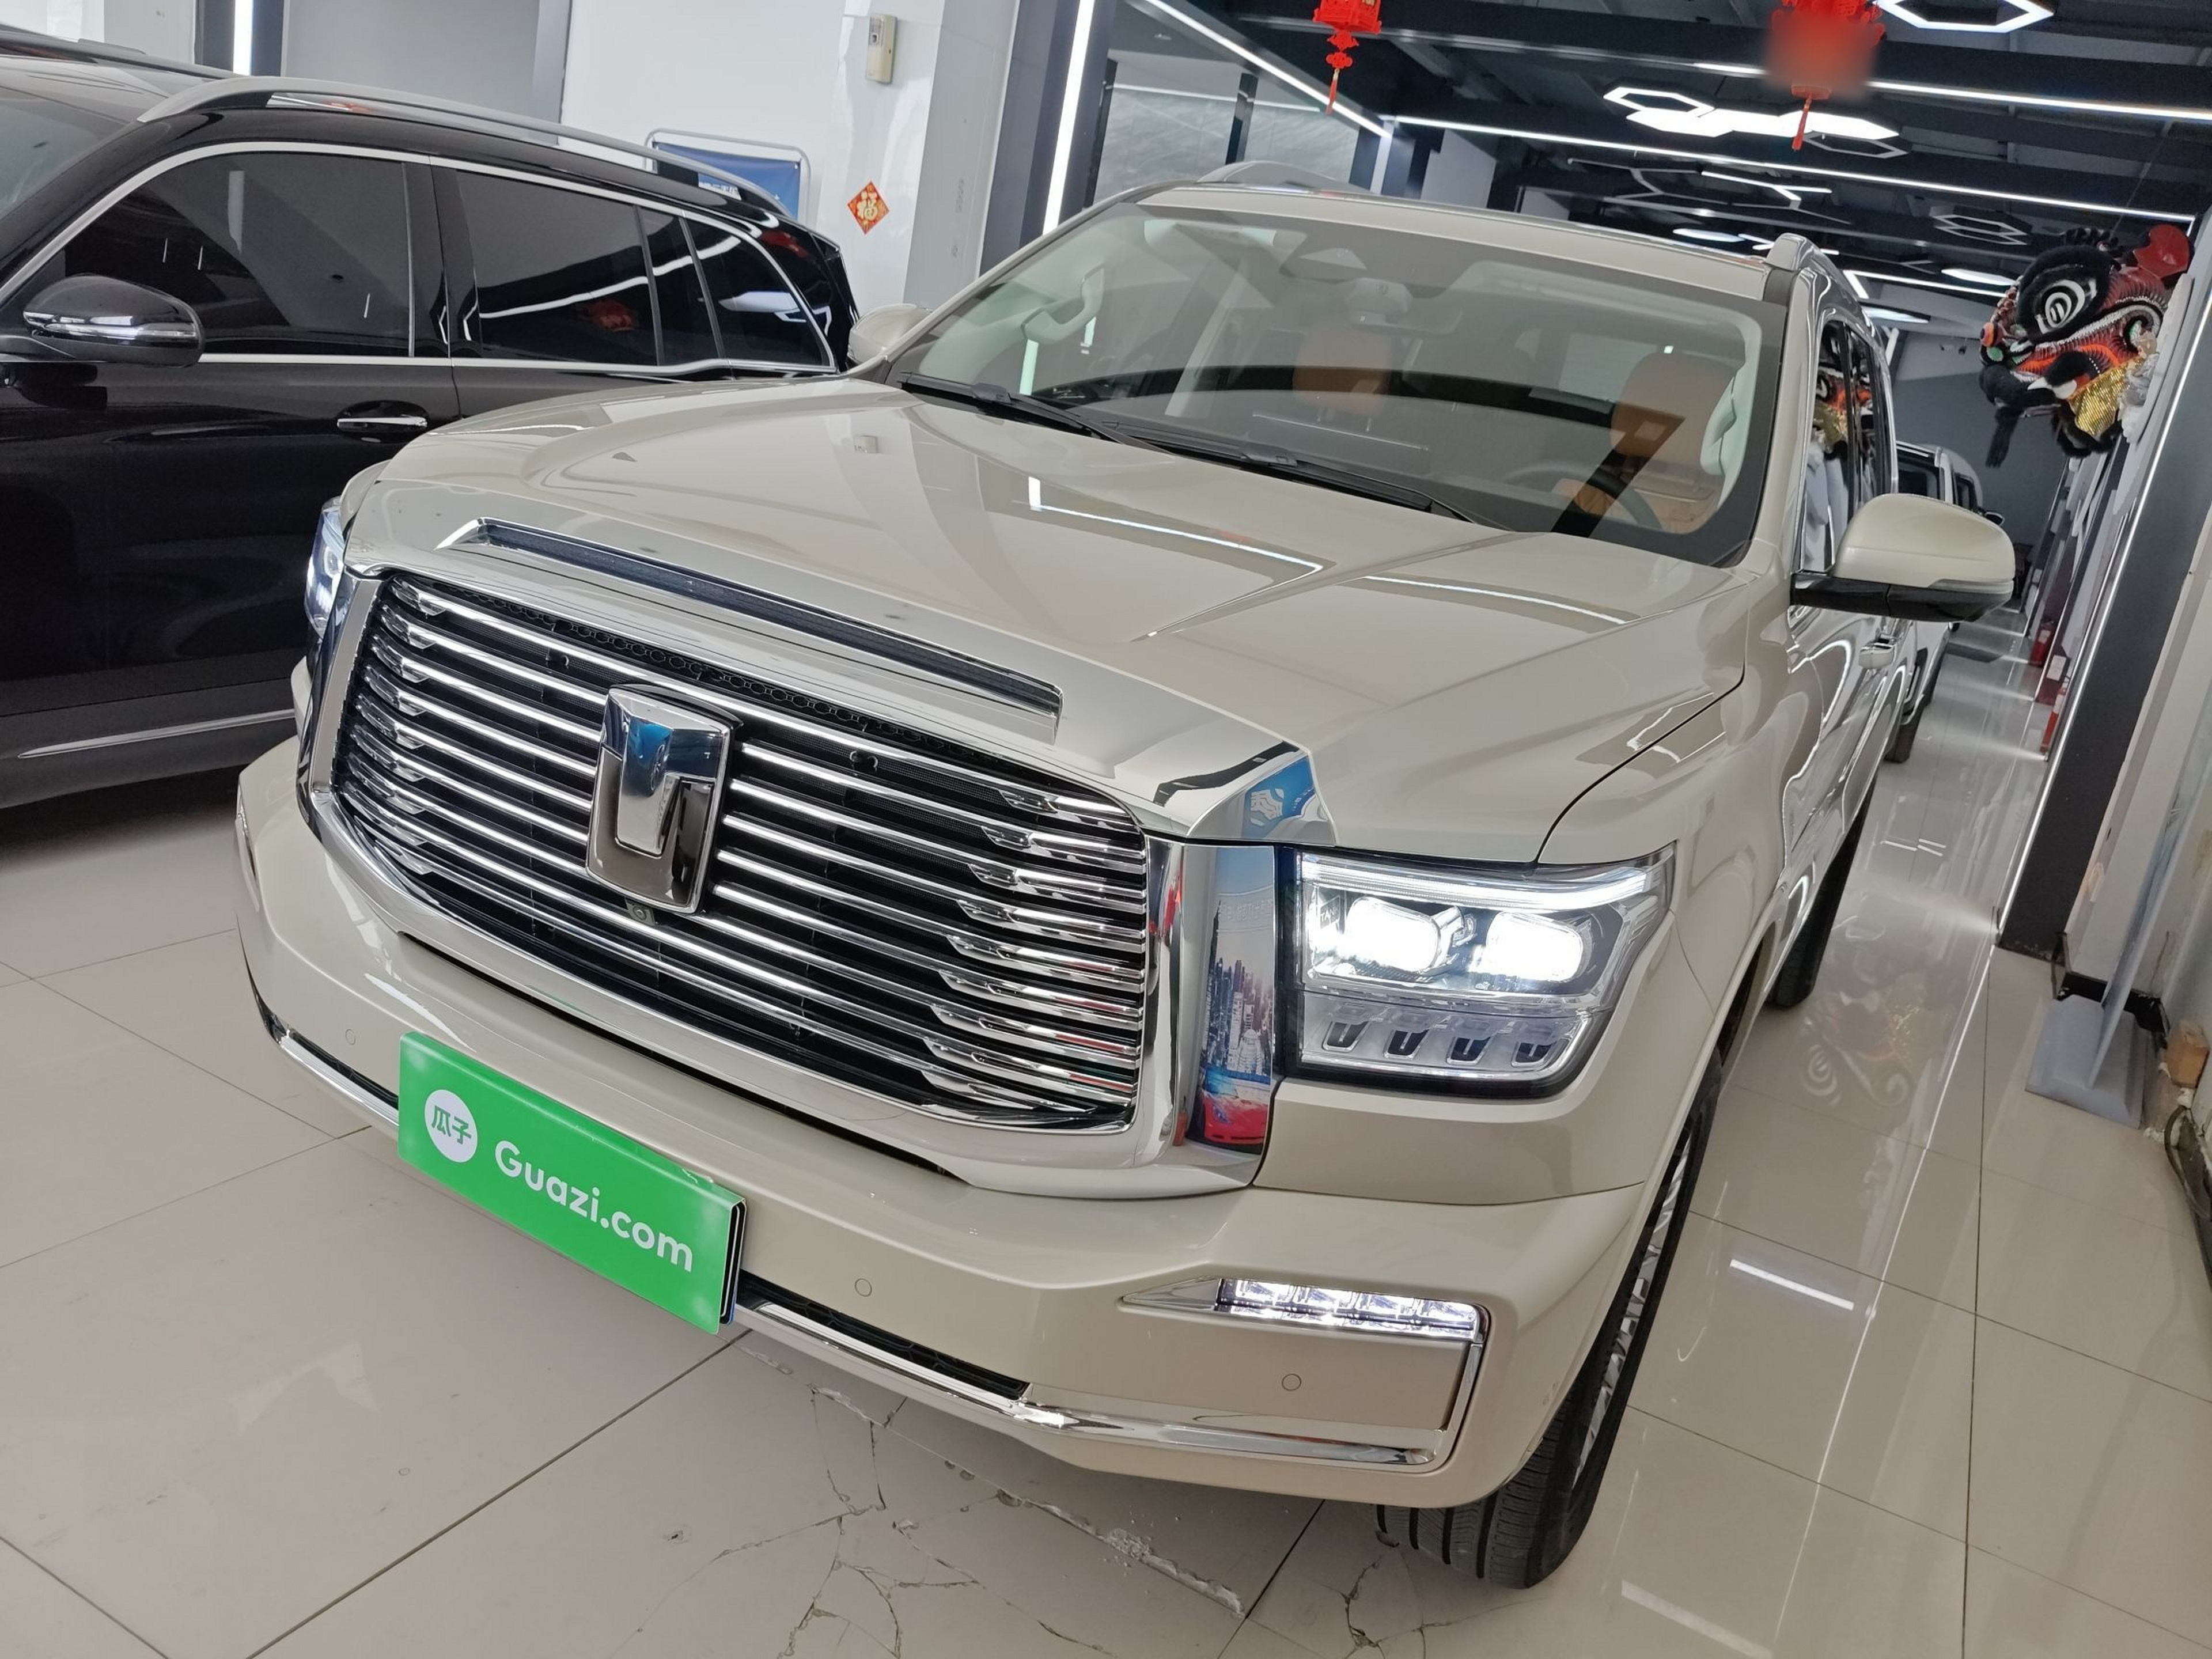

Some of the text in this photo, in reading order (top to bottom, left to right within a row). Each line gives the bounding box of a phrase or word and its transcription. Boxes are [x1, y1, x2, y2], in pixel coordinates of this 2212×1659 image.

[857, 191, 878, 221] 福
[431, 1105, 472, 1145] 瓜子
[495, 1140, 693, 1272] Guazi.com
